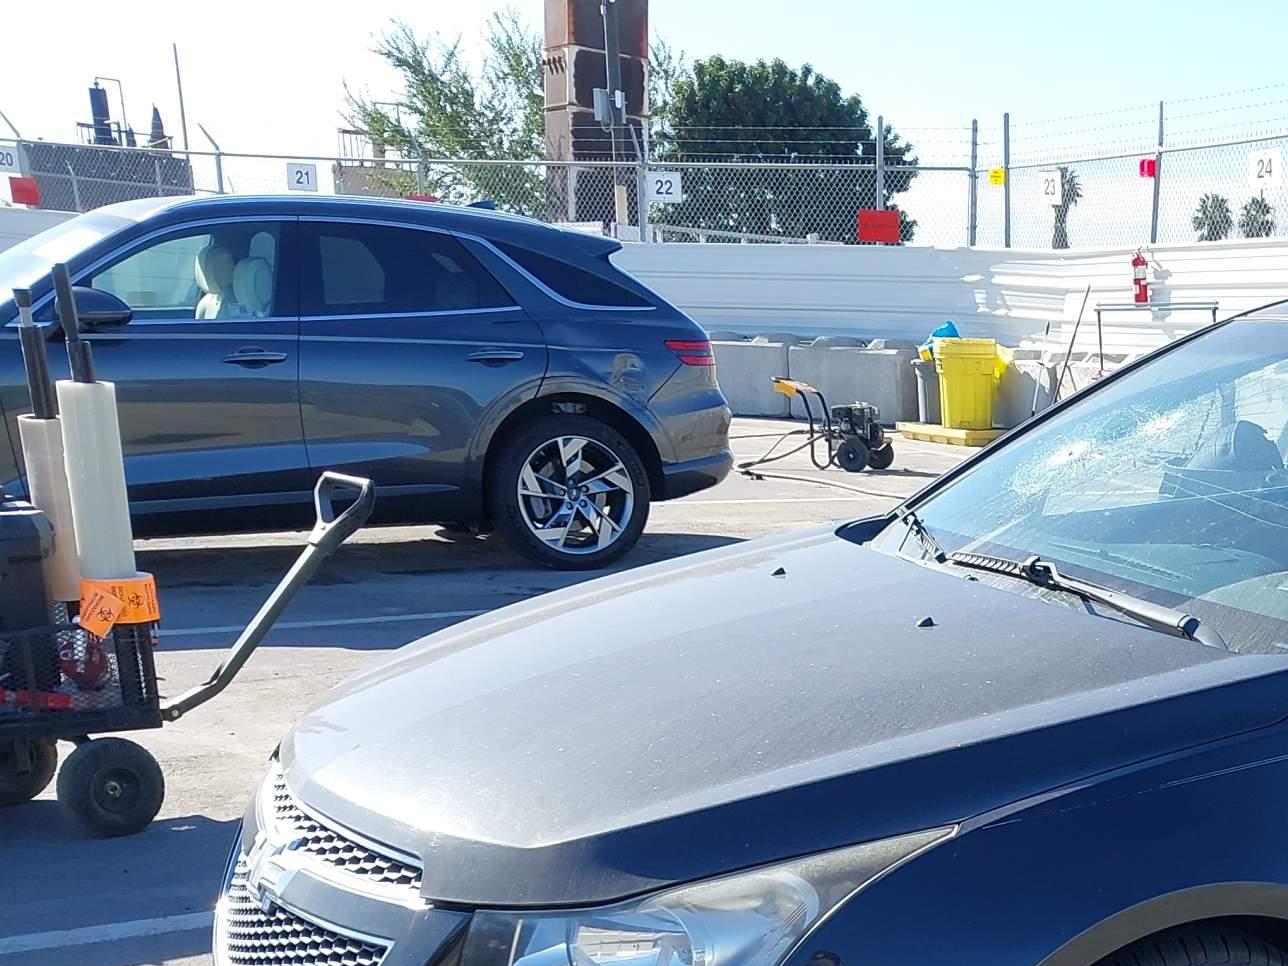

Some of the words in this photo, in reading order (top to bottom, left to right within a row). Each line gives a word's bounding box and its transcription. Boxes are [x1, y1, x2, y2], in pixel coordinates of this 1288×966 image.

[295, 169, 310, 185] 21
[1256, 158, 1273, 179] 24
[655, 179, 674, 195] 22
[1044, 177, 1056, 196] 23
